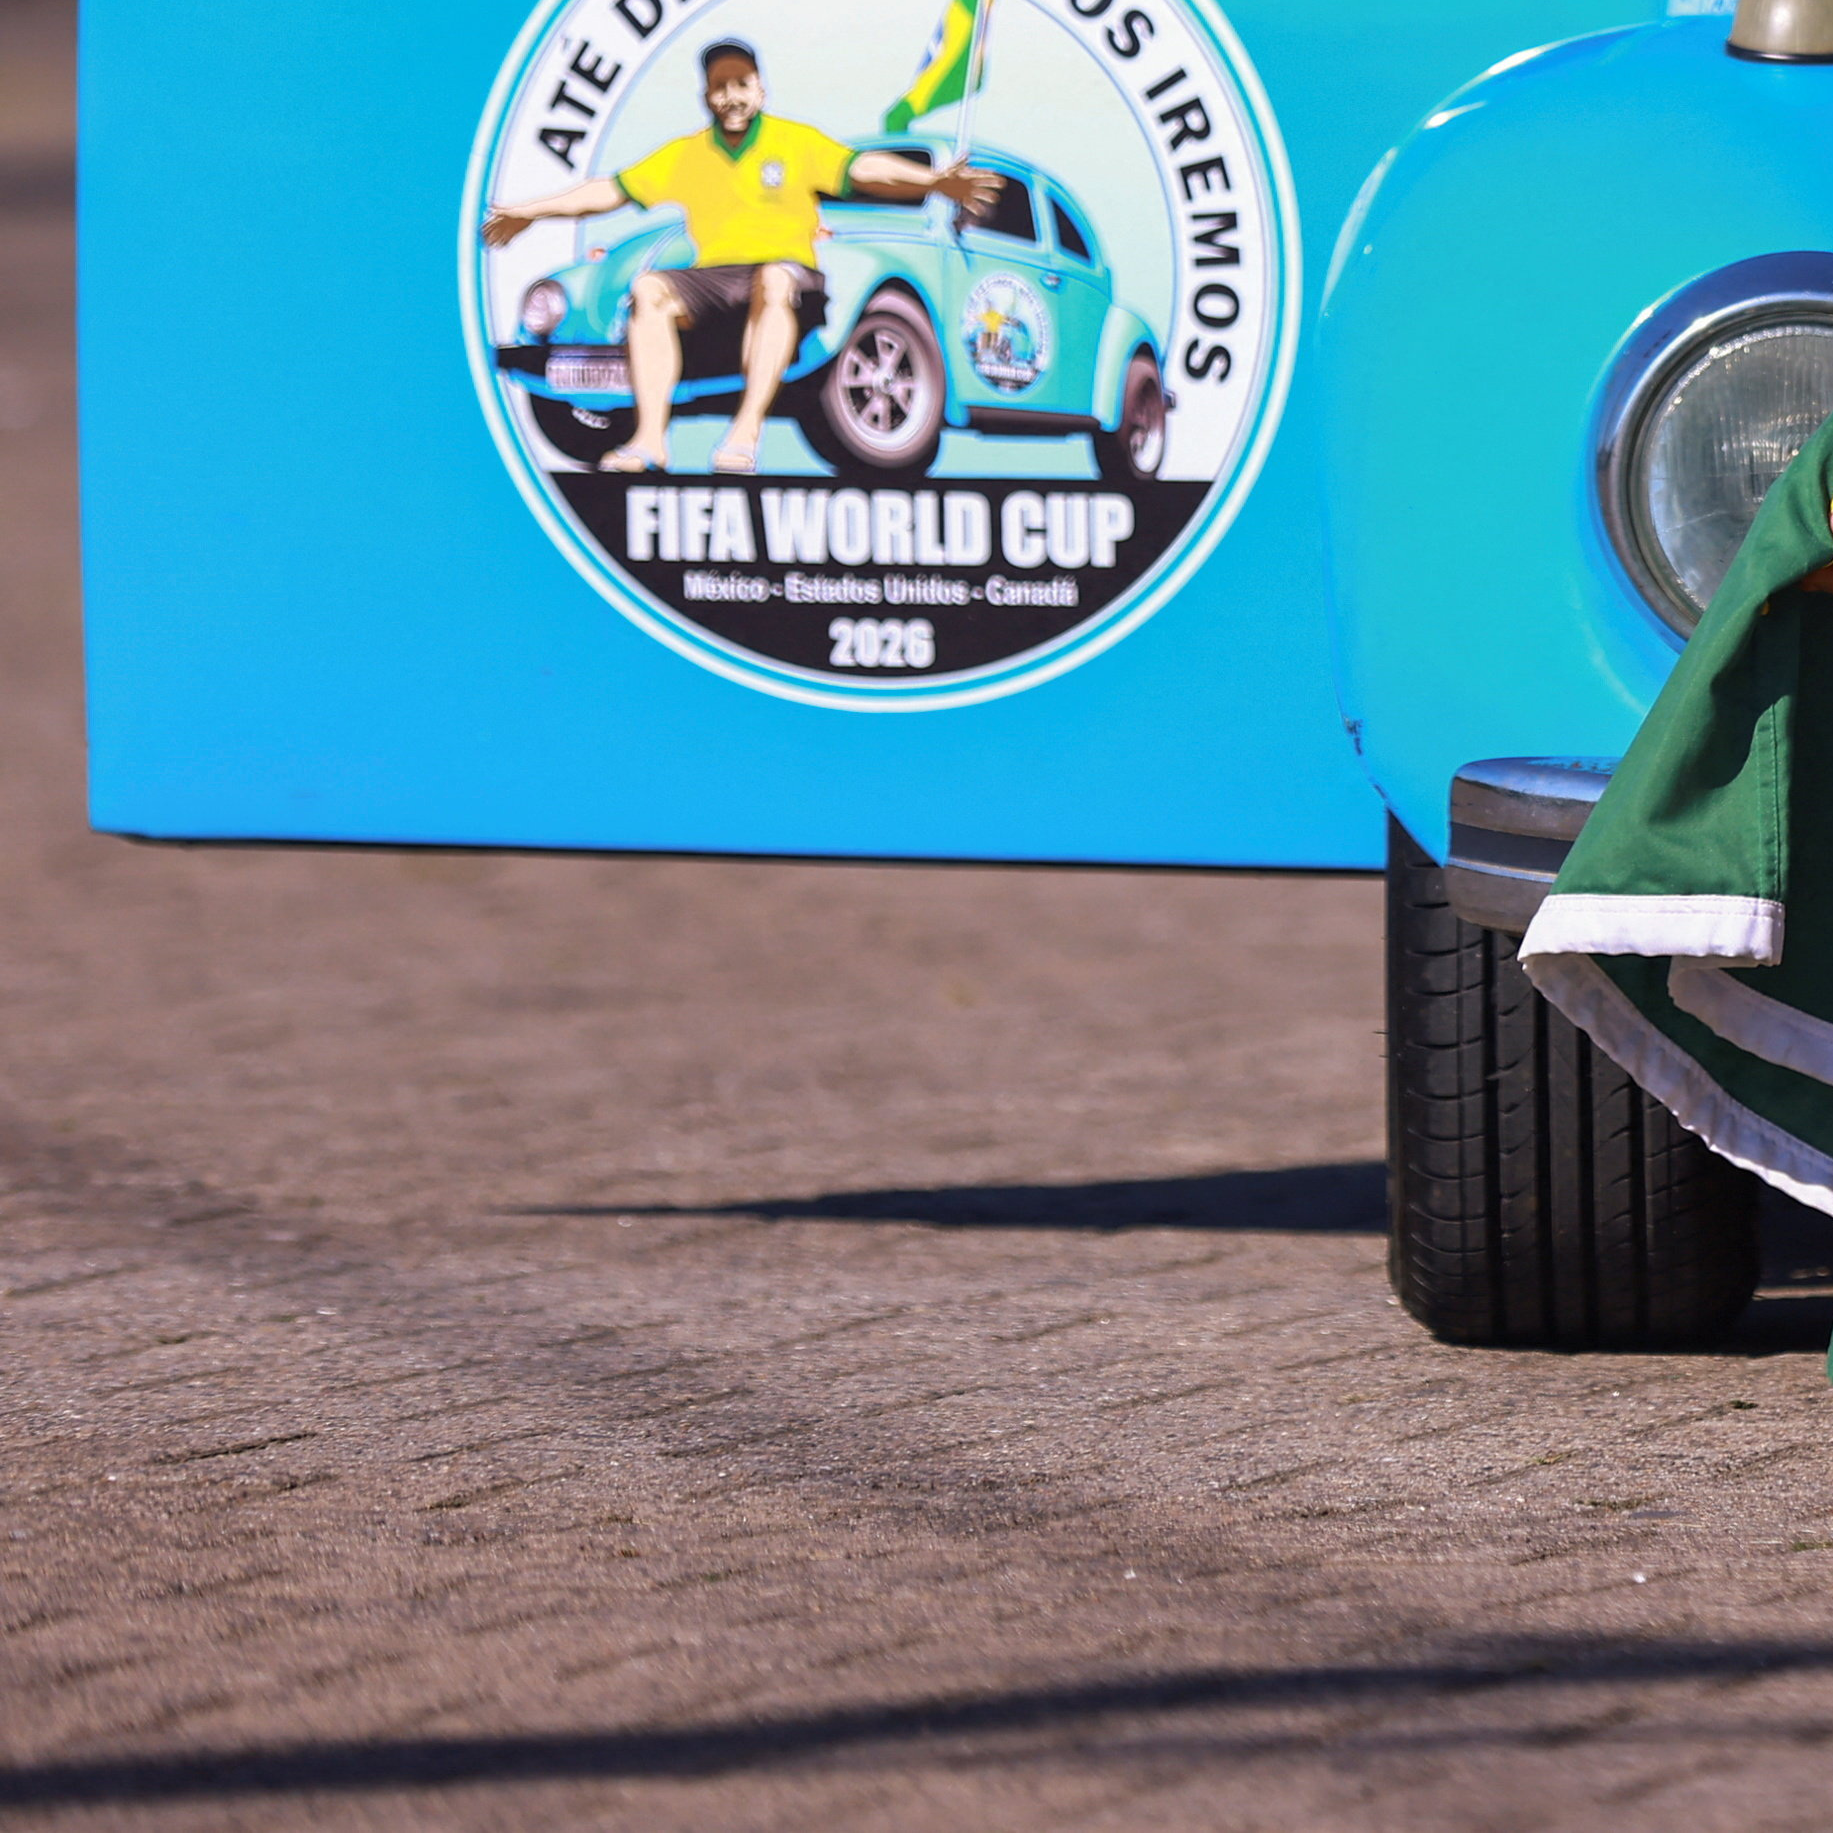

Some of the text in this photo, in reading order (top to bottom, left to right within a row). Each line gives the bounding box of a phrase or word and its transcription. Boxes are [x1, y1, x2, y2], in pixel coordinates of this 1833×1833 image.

[538, 34, 622, 168] ATÉ
[1143, 66, 1241, 385] IREMOS
[626, 486, 1135, 568] FIFA WORLD CUP
[683, 569, 769, 602] México
[784, 571, 880, 604] Estados
[884, 572, 970, 605] Unidos
[985, 574, 1079, 607] Canadá
[828, 616, 936, 668] 2026
